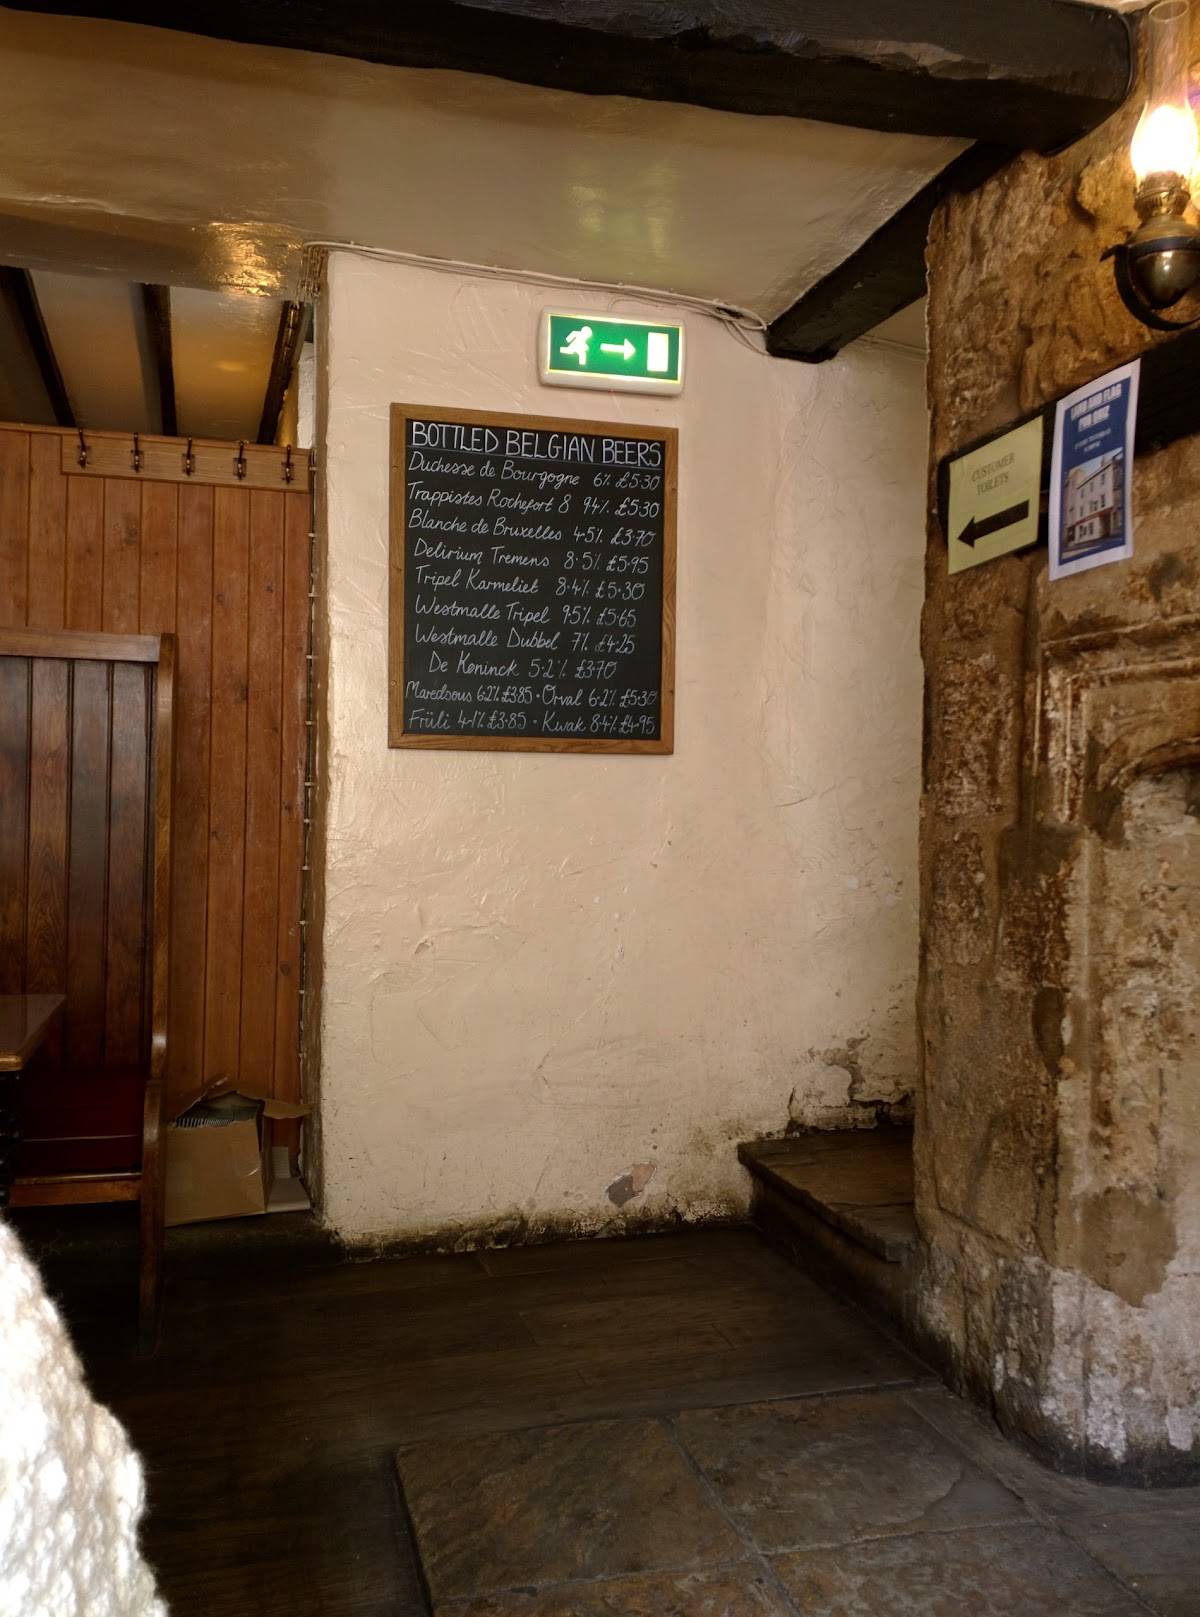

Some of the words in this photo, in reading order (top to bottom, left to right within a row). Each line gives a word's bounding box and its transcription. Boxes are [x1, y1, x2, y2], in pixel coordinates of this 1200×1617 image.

[412, 421, 499, 453] BOTTLED
[505, 430, 595, 463] BELGIAN
[602, 439, 661, 467] BEERS
[408, 451, 476, 477] Duchesse
[479, 460, 496, 477] de
[501, 460, 580, 489] Bourgogne
[408, 481, 483, 507] Trappistes
[487, 488, 554, 515] Rochefort
[558, 494, 572, 514] 8
[408, 508, 467, 533] Blanche
[471, 518, 489, 534] de
[493, 516, 562, 540] Bruxelles
[414, 538, 483, 565] Delirium
[491, 546, 550, 568] Tremens
[415, 564, 462, 591] Tripel
[465, 568, 539, 594] Karmeliet
[415, 594, 501, 620] Westmalle
[506, 601, 551, 627] Tripel
[415, 623, 498, 648] Westmalle
[507, 627, 561, 650] Dubbel
[429, 650, 448, 673] De
[456, 650, 520, 677] Koninck
[405, 680, 472, 702] Maredsous
[542, 684, 583, 706] Orval
[542, 711, 587, 732] Kwak
